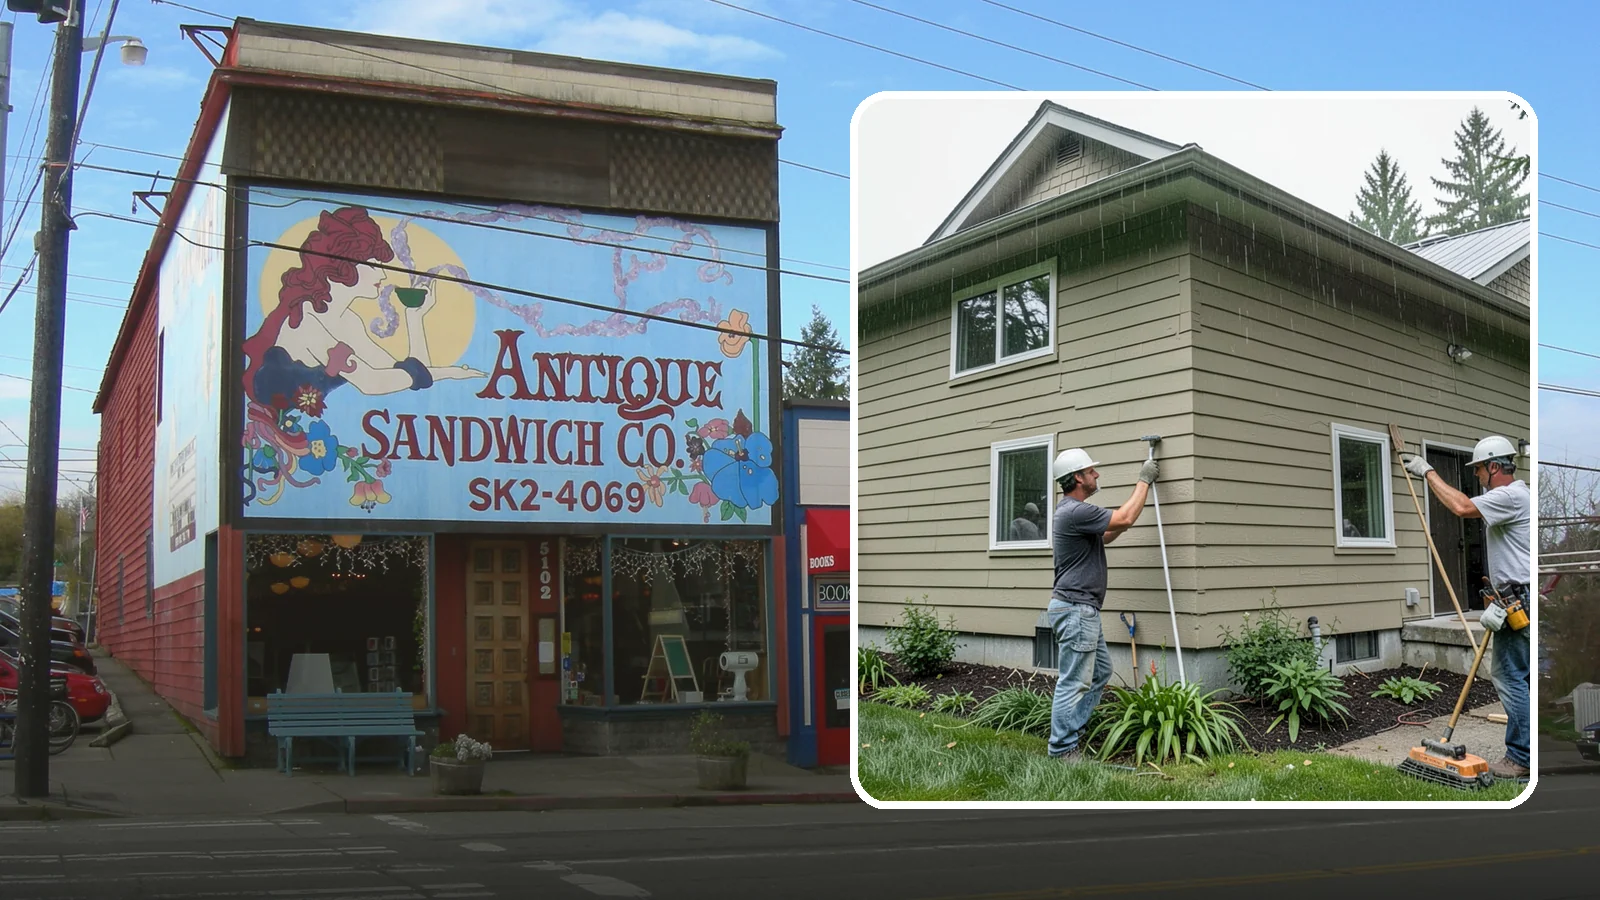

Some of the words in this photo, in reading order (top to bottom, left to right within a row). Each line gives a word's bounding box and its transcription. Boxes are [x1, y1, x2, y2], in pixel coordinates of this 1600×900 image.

[476, 329, 723, 420] ANTIQUE
[361, 408, 604, 467] SANDWICH
[617, 423, 685, 468] CO.
[468, 477, 645, 513] SK2-4069
[540, 542, 551, 599] 5102
[809, 555, 834, 569] BOOKS
